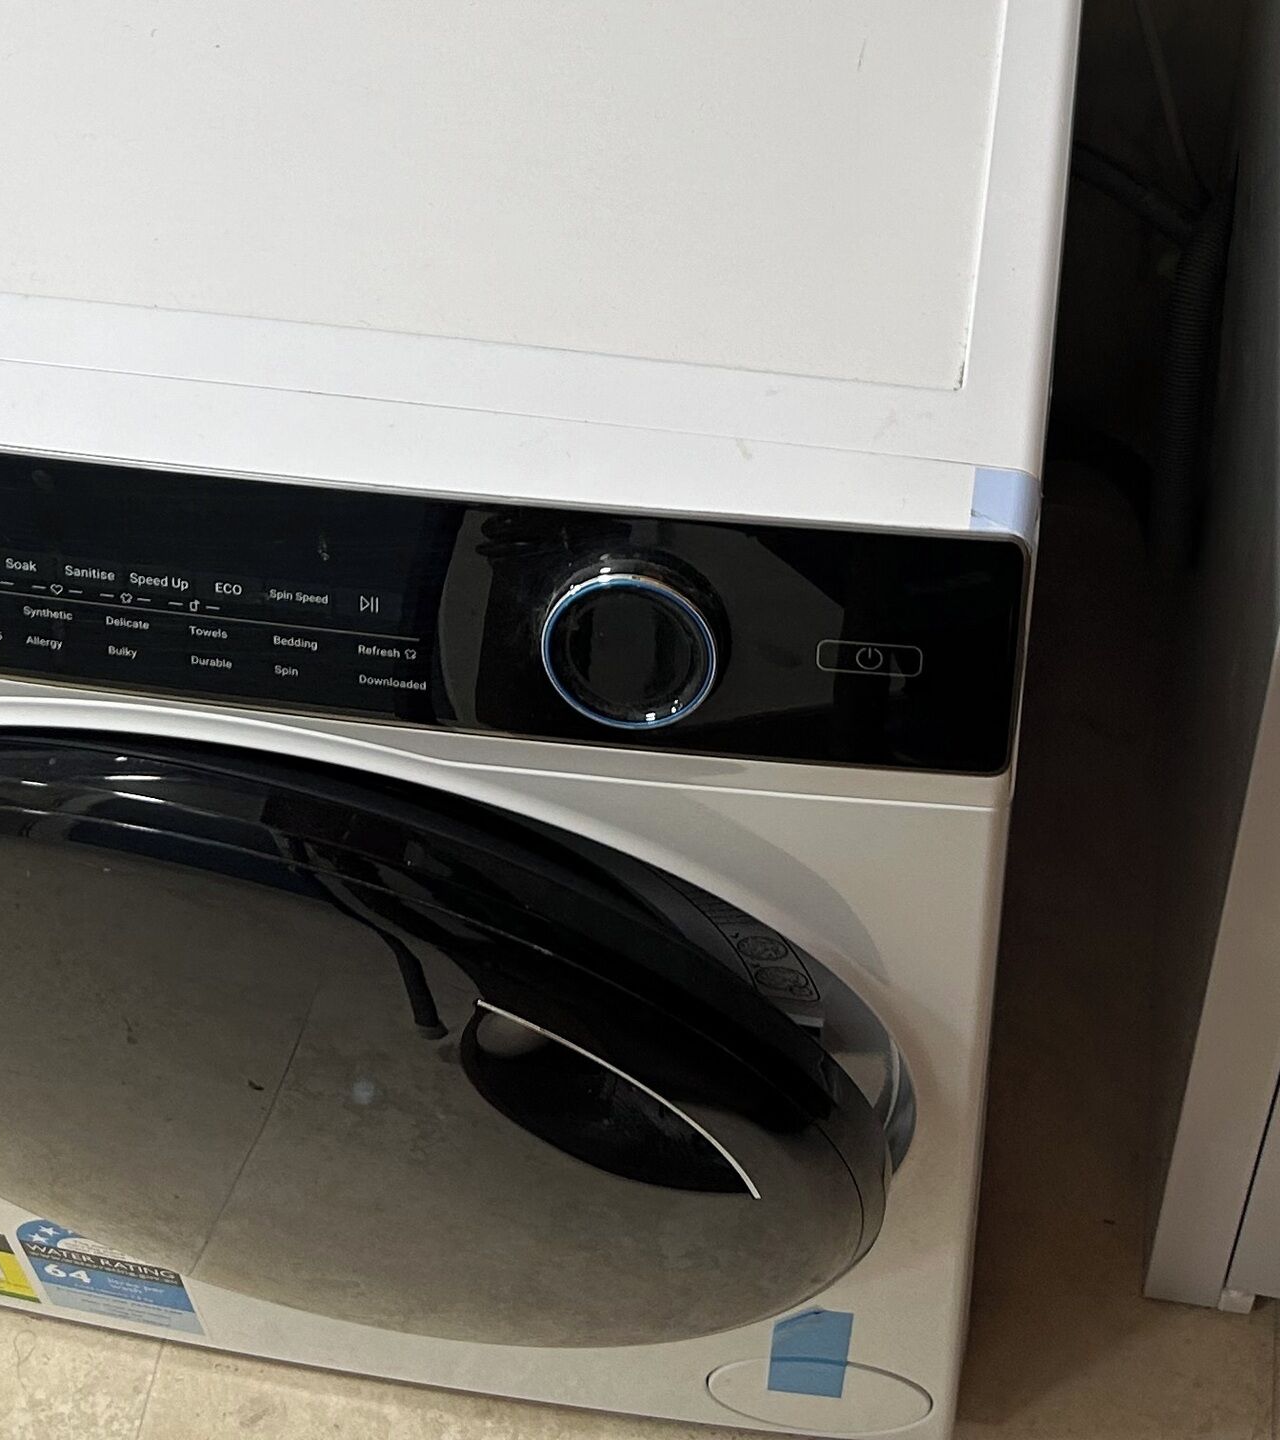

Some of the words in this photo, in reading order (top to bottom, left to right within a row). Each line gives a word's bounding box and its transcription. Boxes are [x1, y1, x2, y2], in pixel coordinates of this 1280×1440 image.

[5, 558, 37, 572] Soak
[64, 565, 116, 581] Sanitise
[129, 572, 168, 589] Speed
[171, 577, 189, 591] Up
[215, 582, 243, 596] ECO
[269, 589, 293, 601] Spin
[295, 591, 329, 605] Speed
[23, 606, 73, 621] Synthetic
[105, 616, 150, 630] Delicate
[189, 625, 228, 639] Towels
[273, 635, 318, 652] Bedding
[358, 644, 401, 659] Refresh
[26, 636, 63, 650] Allergy
[108, 645, 138, 660] Bulky
[191, 655, 233, 669] Durable
[274, 665, 299, 677] Spin
[359, 674, 427, 691] Downloaded
[25, 1243, 96, 1264] WATER
[100, 1257, 175, 1279] RATING
[43, 1264, 91, 1284] 64
